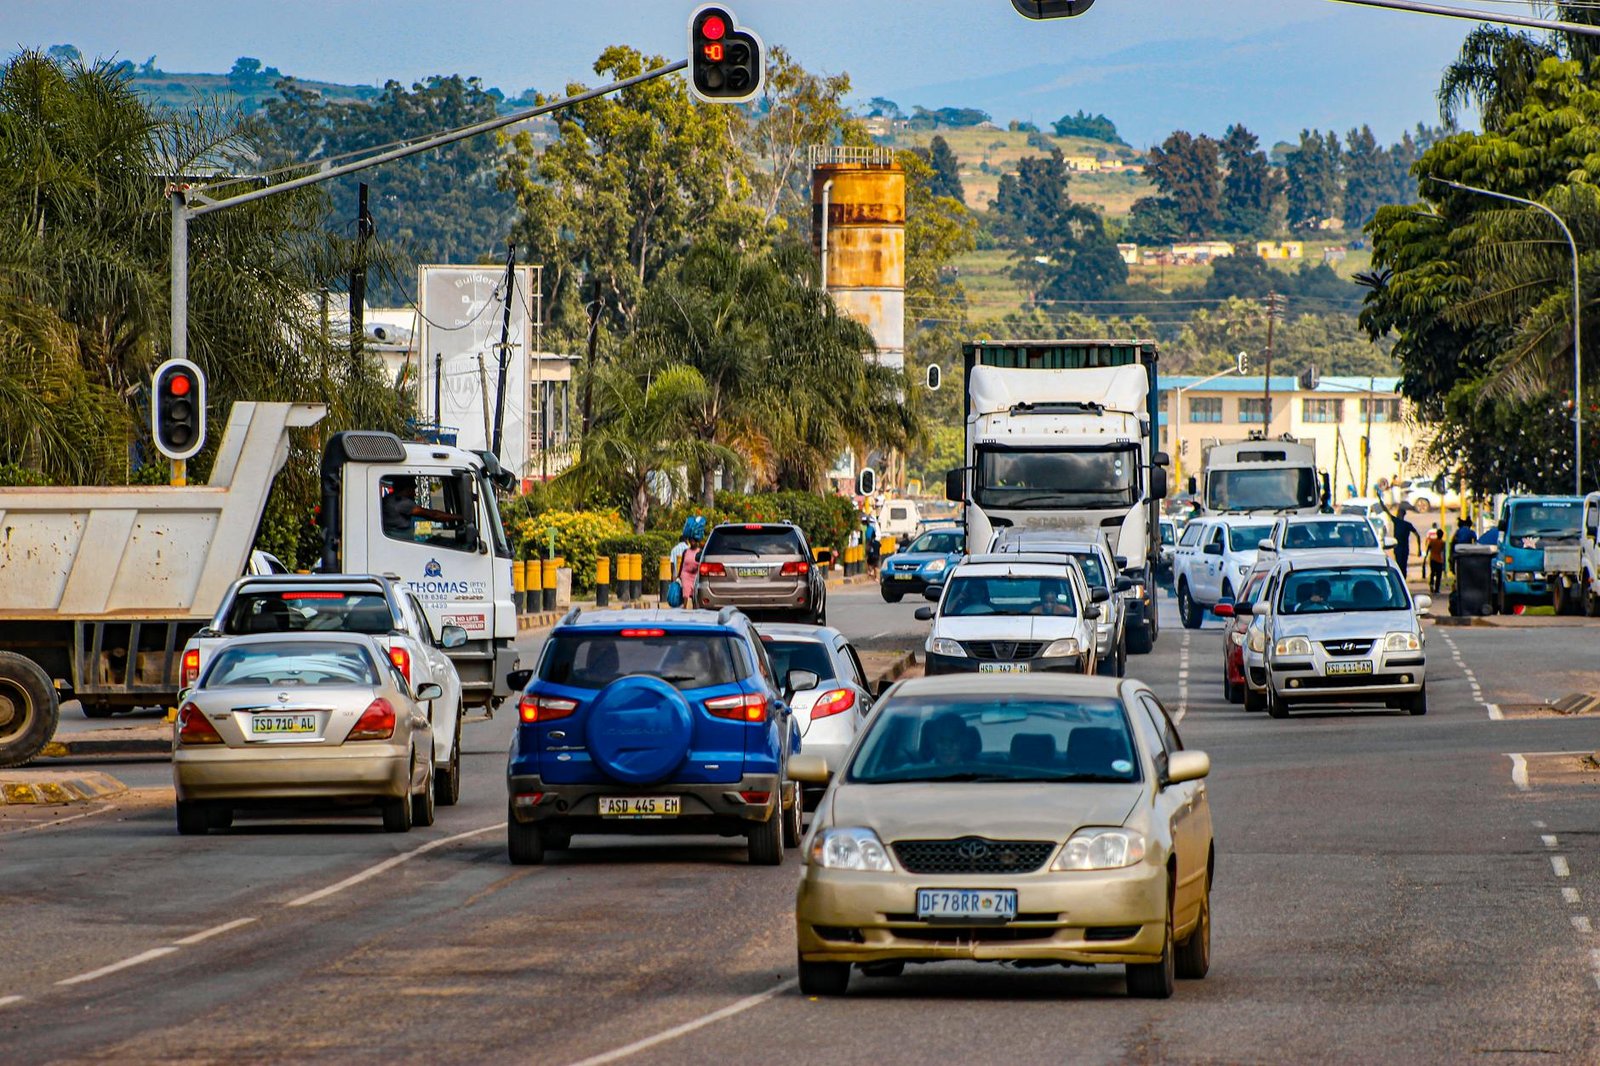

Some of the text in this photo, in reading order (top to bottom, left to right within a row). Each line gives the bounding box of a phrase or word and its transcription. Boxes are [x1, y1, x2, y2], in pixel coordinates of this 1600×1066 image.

[703, 44, 722, 60] 40
[455, 274, 499, 289] Builders
[407, 582, 468, 593] THOMAS
[255, 718, 313, 730] TSD 710 AL
[609, 799, 678, 812] ASD 445 EH
[922, 893, 1013, 912] DF78RR ZN
